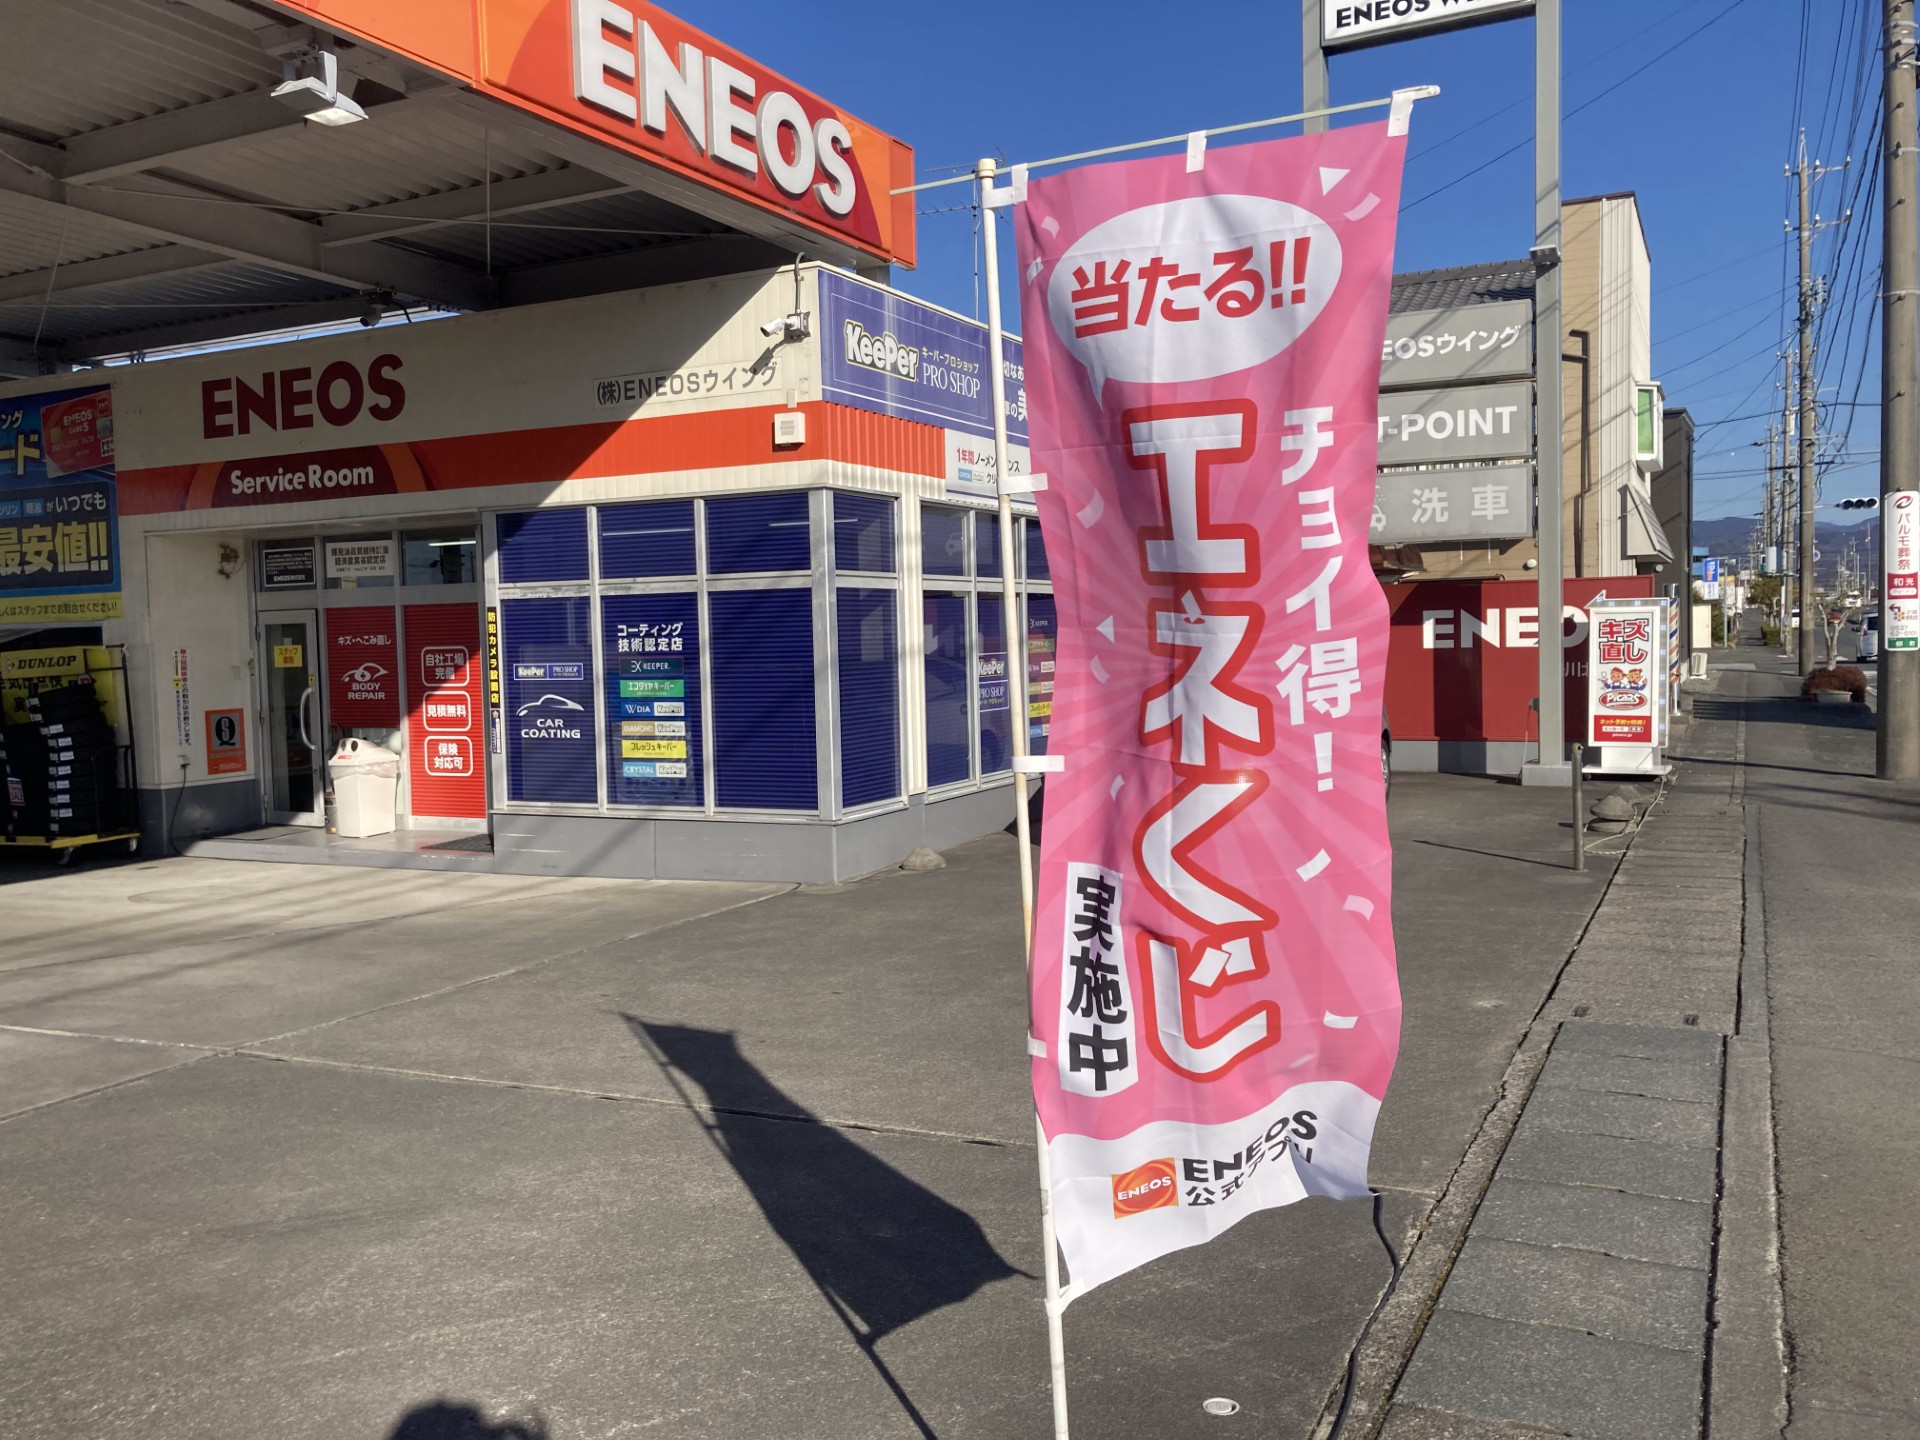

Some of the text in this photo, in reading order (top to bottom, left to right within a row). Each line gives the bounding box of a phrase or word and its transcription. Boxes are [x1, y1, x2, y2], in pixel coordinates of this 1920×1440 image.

[1336, 0, 1431, 29] ENEOS
[570, 0, 856, 215] ENEOS
[1070, 236, 1312, 339] 当たる!!
[845, 321, 918, 382] KeePer
[921, 346, 980, 375] キーパープロショップ
[922, 362, 981, 400] PRO SHOP
[202, 353, 406, 440] ENEOS
[230, 464, 374, 495] Service Room
[1275, 405, 1362, 792] チョイ得!
[617, 622, 684, 637] コーティング
[1598, 618, 1649, 642] キズ
[618, 637, 683, 653] 技術認定店
[1598, 641, 1648, 665] 直し
[17, 655, 78, 670] DUNLOP
[425, 653, 466, 668] 自社工場
[517, 666, 545, 678] KeePer
[347, 691, 386, 700] REPAIR
[352, 683, 381, 691] BODY
[427, 704, 467, 718] 見積無料
[536, 718, 564, 728] CAR
[521, 728, 581, 739] COATING
[438, 743, 459, 756] 保険
[433, 756, 464, 770] 対応可
[625, 766, 655, 774] CRYSTAL
[1066, 874, 1129, 1092] 実施中
[1183, 1110, 1318, 1183] ENEOS
[1117, 1175, 1172, 1201] ENEOS
